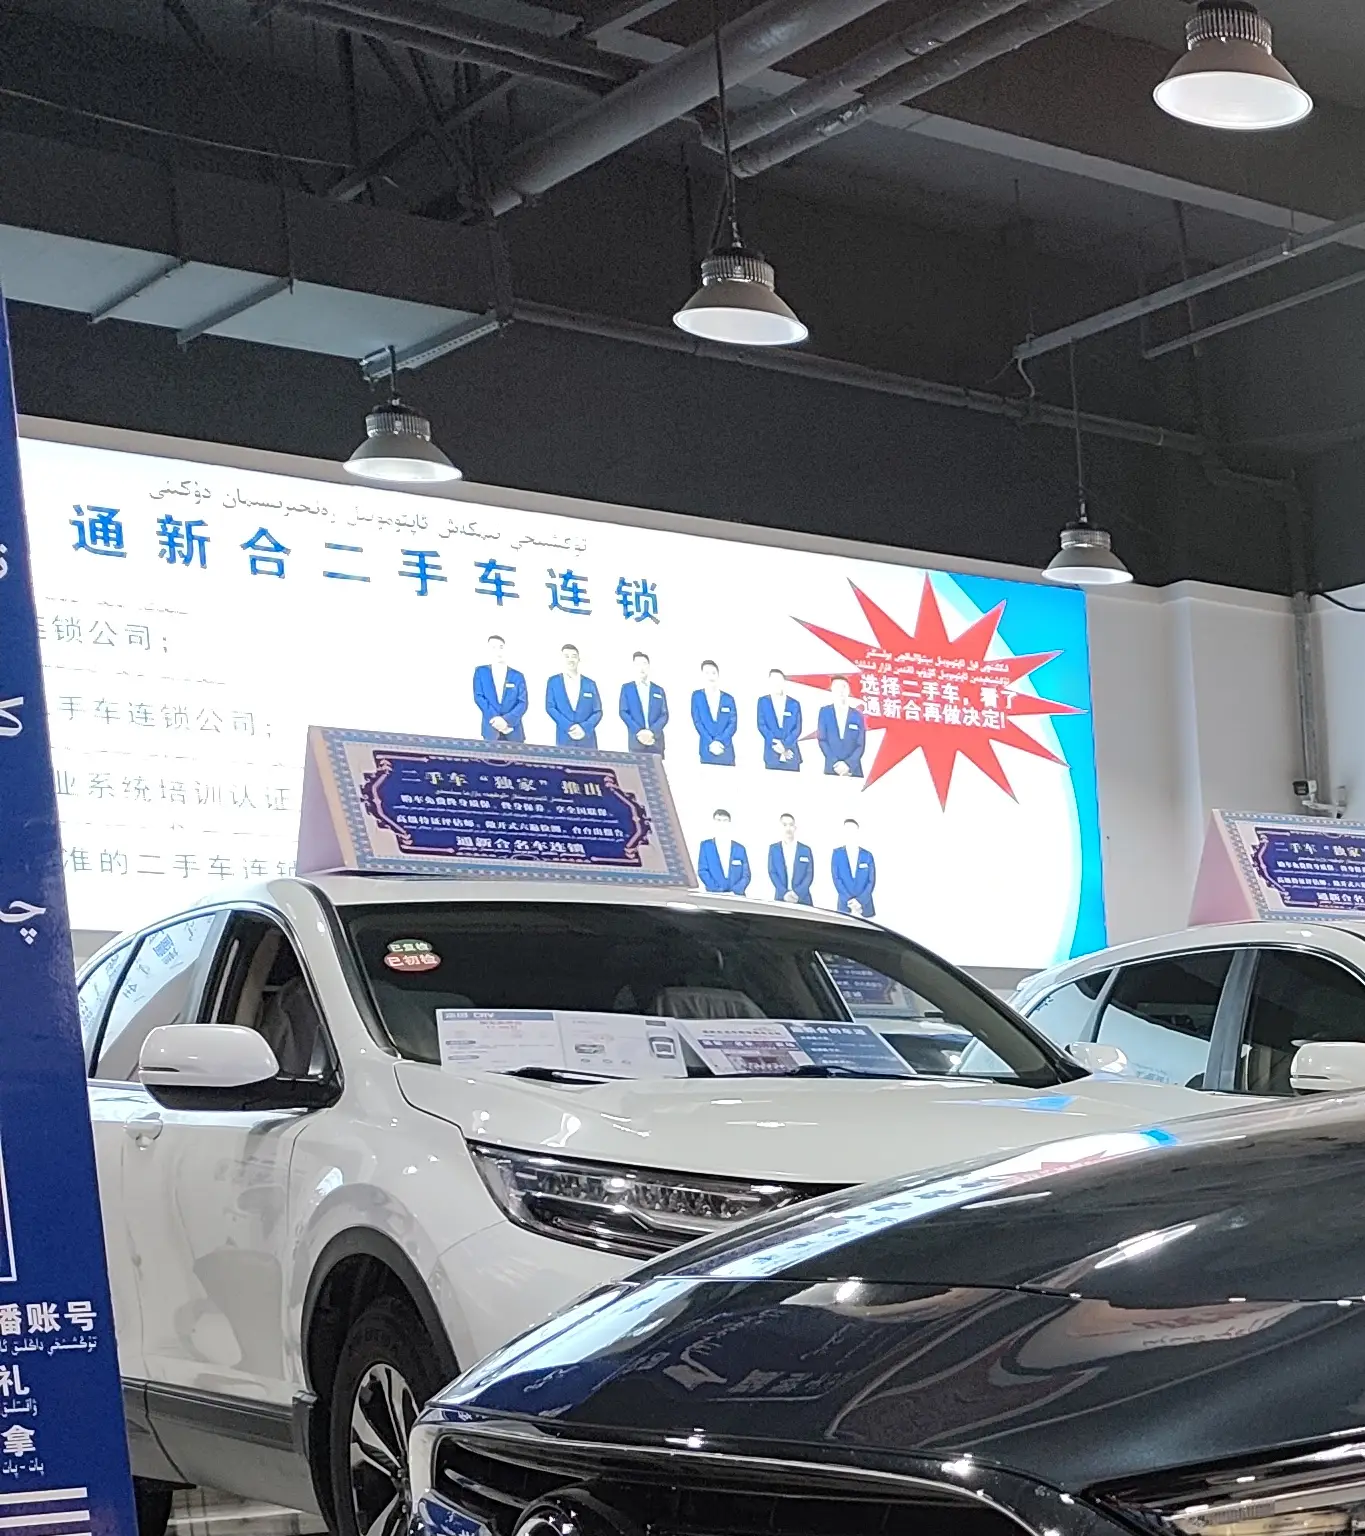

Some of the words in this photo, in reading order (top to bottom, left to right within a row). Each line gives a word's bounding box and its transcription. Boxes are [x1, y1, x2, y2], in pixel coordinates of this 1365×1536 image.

[69, 503, 660, 625] 通新合二手车连锁
[0, 1365, 30, 1396] 礼
[1, 1425, 36, 1457] 拿
